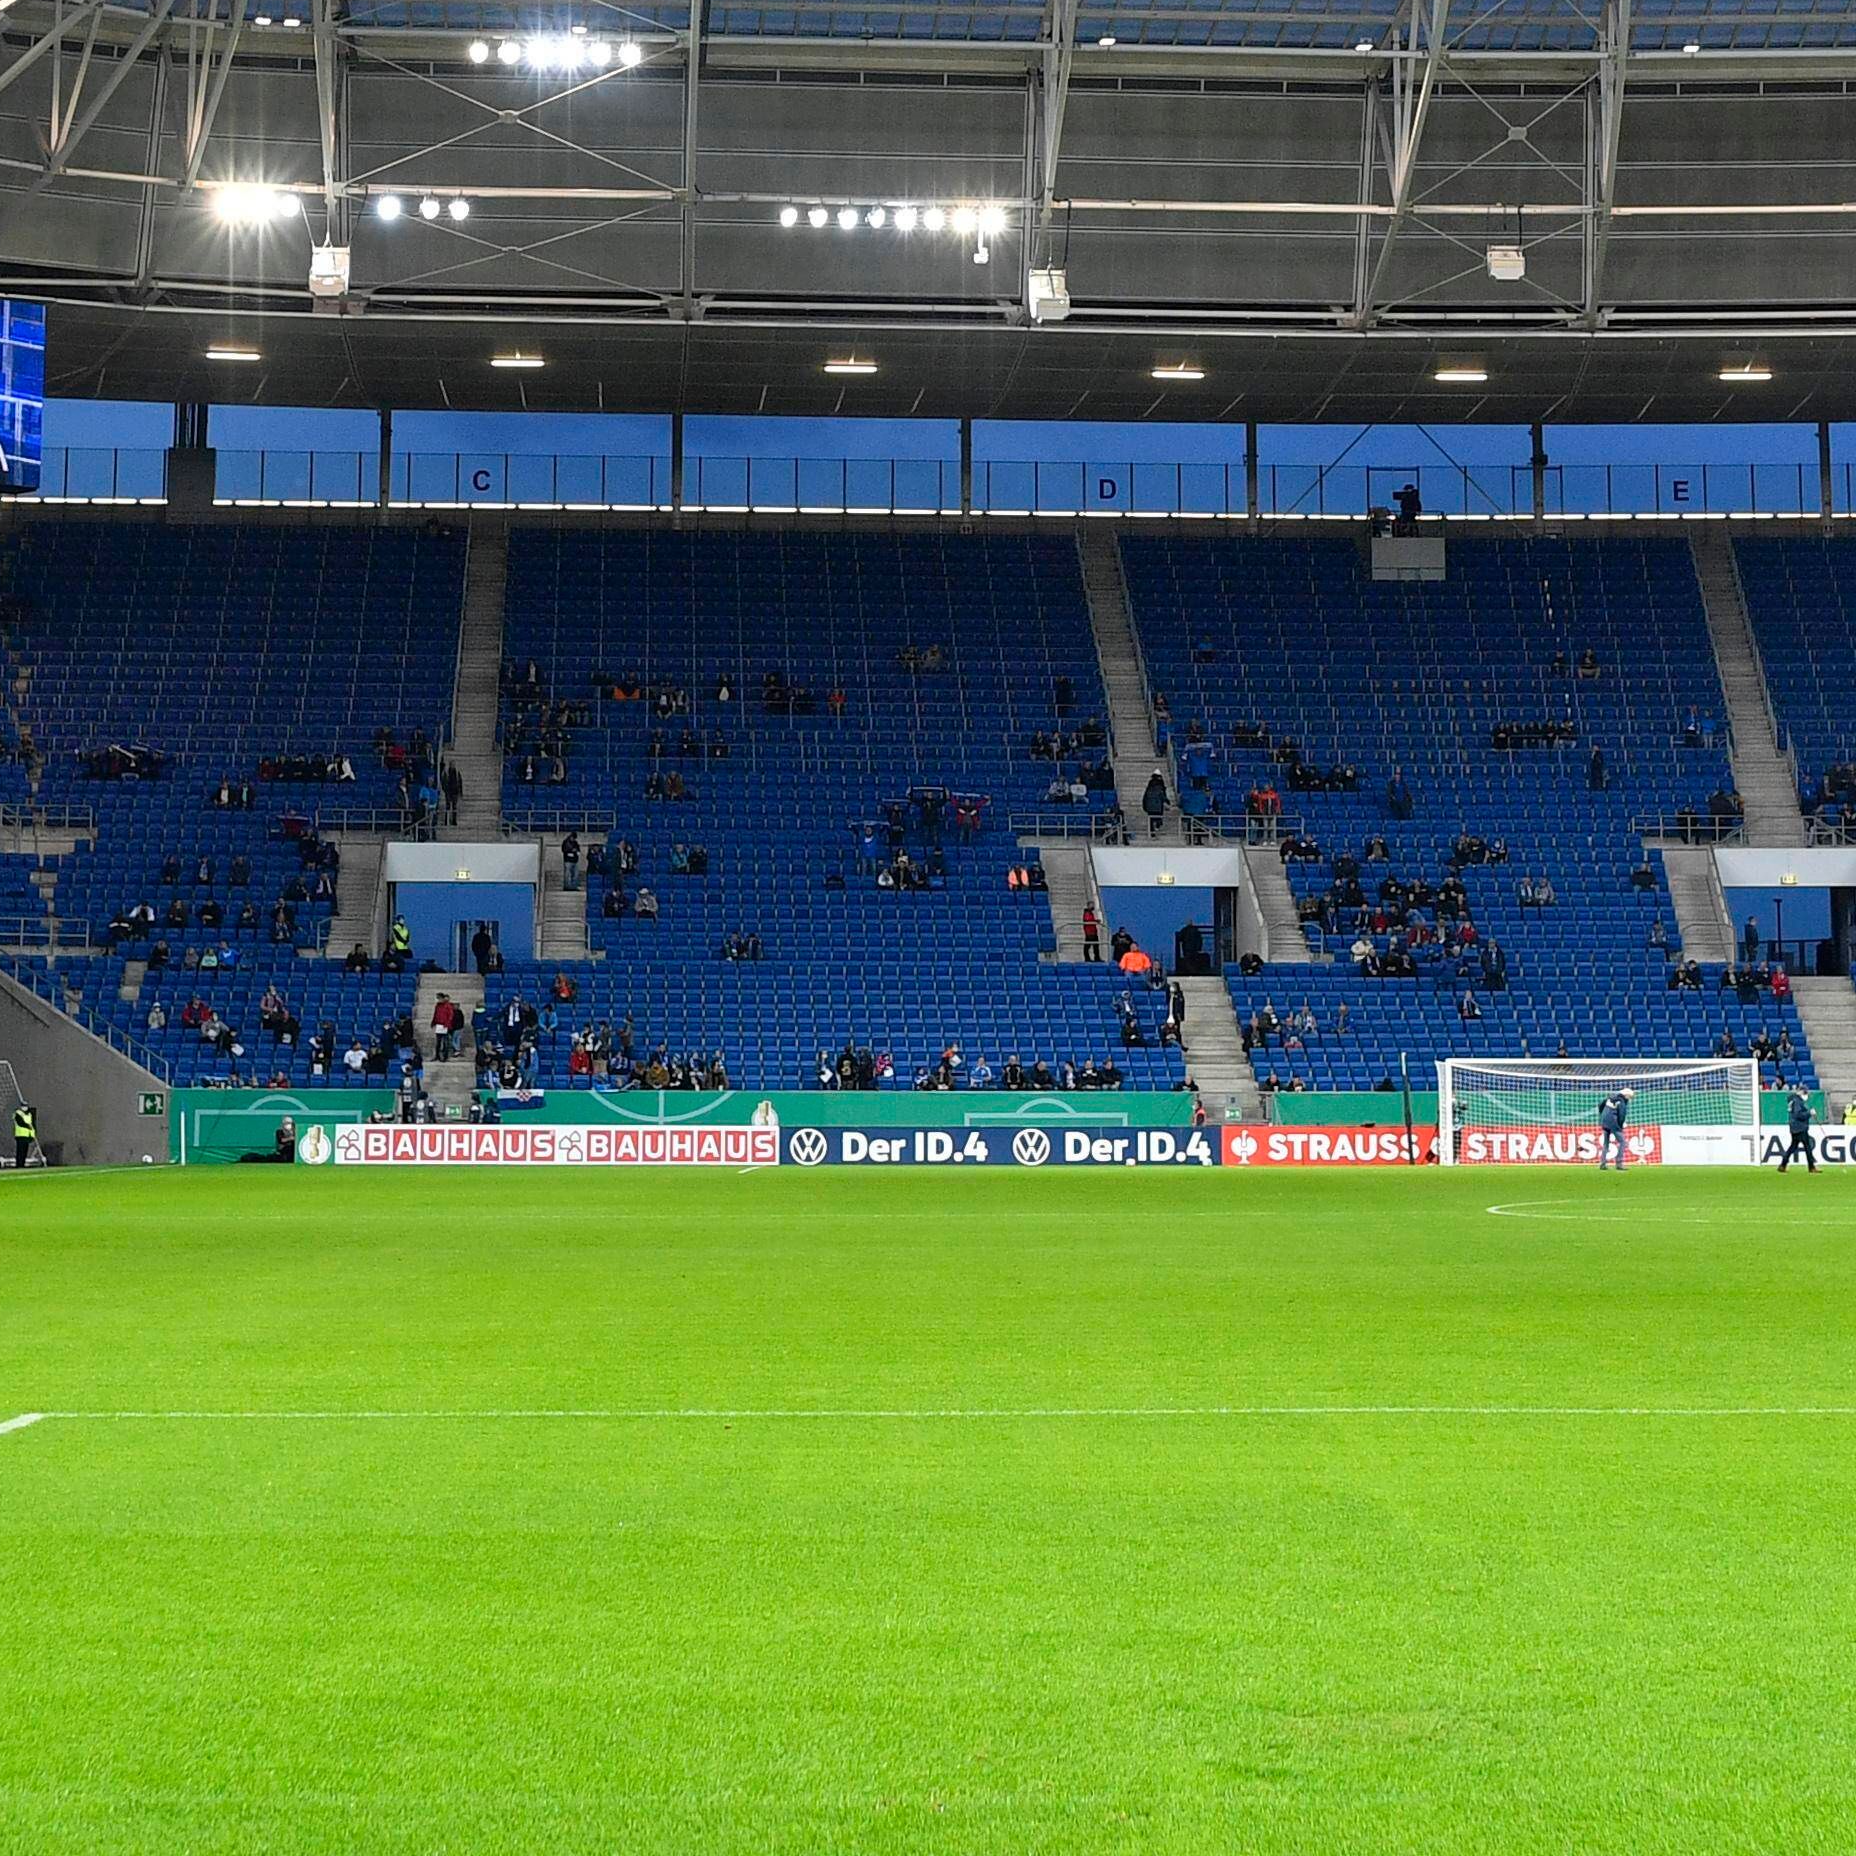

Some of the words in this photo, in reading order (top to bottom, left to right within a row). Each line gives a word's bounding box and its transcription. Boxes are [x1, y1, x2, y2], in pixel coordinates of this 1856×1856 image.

[472, 470, 491, 491] C
[1099, 479, 1116, 500] D
[1673, 481, 1689, 502] E
[367, 1131, 553, 1159] BAUHAUS
[588, 1132, 776, 1160] BAUHAUS
[843, 1131, 907, 1162] Der
[915, 1132, 988, 1162] ID.4
[1065, 1131, 1129, 1162] Der
[1137, 1132, 1210, 1162] ID.4
[1268, 1134, 1420, 1161] STRAUSS
